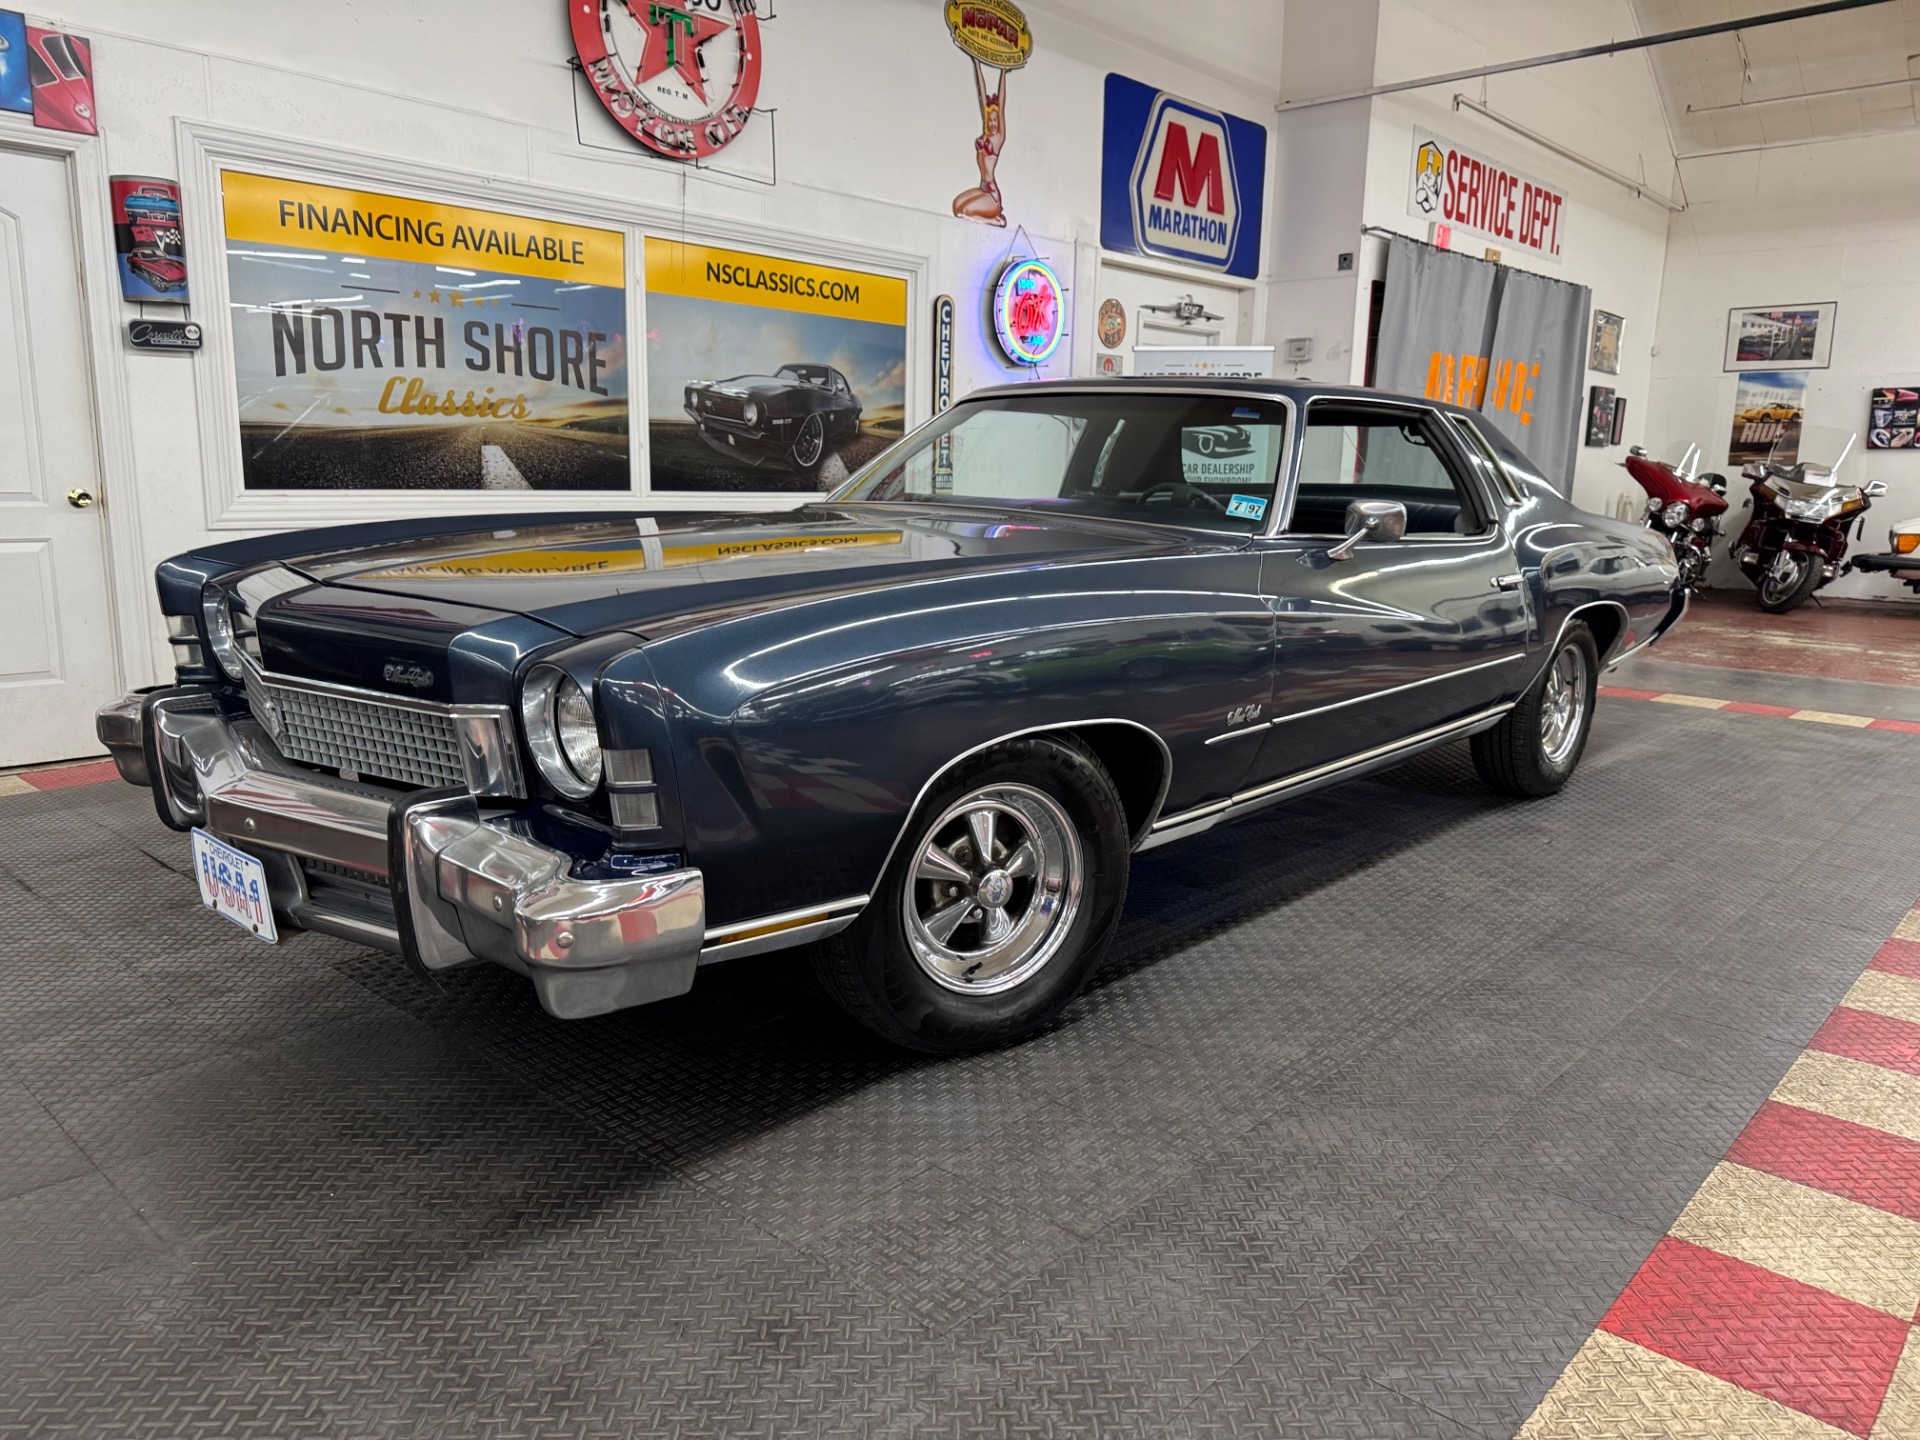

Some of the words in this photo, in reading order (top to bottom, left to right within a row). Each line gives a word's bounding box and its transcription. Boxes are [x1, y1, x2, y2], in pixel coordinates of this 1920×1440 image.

[961, 7, 1019, 49] MOPAR
[1154, 120, 1225, 215] M
[1443, 148, 1518, 241] SERVICE
[1518, 181, 1563, 256] DEPT.
[278, 199, 445, 248] FINANCING
[451, 224, 585, 266] AVAILABLE
[1148, 204, 1228, 246] MARATHON
[705, 260, 860, 304] NSCLASSICS.COM
[131, 323, 187, 343] Corvette
[270, 301, 446, 378] NORTH
[463, 320, 609, 397] SHORE
[377, 375, 533, 420] Classics
[938, 304, 952, 467] CHEVROET
[1200, 463, 1255, 475] DEALERSHIP
[1233, 501, 1243, 511] 7
[1247, 504, 1262, 515] 97
[208, 843, 244, 871] CHEVROLET
